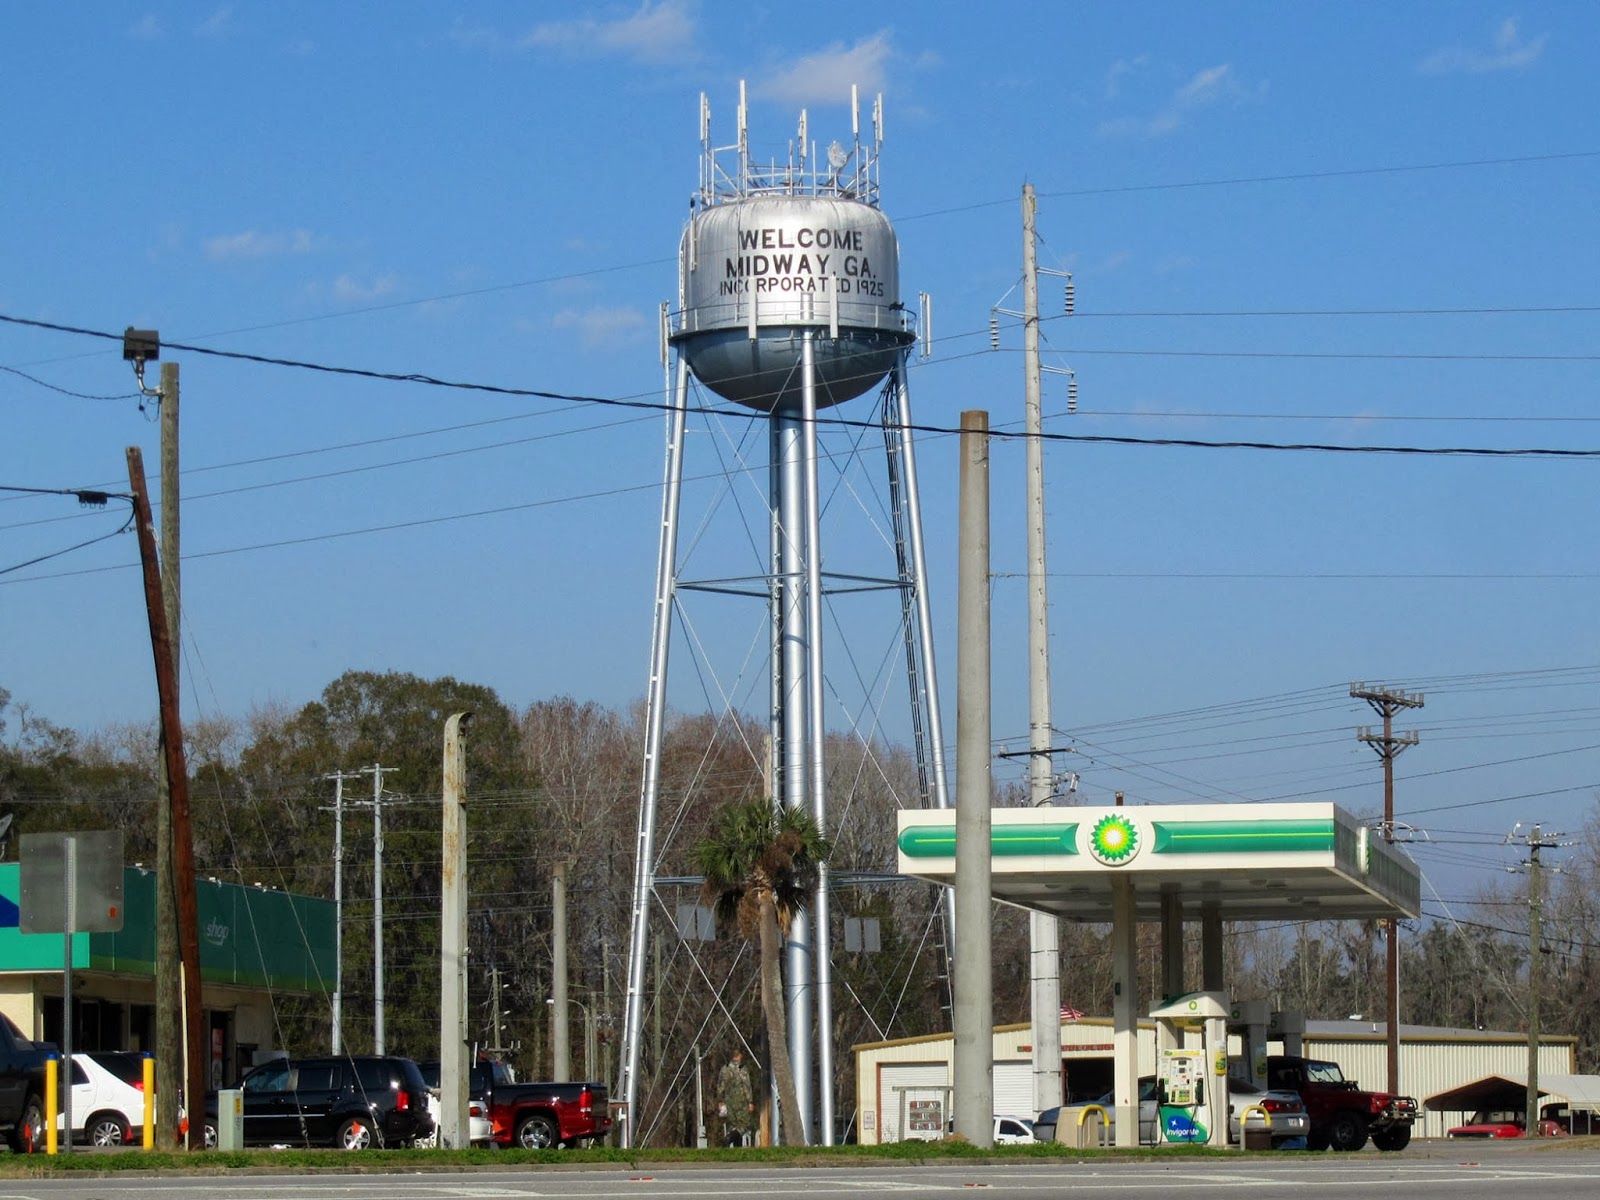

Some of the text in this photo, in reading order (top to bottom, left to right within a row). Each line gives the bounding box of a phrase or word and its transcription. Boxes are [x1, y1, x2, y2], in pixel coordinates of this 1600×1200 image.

[739, 228, 863, 251] WELCOME
[844, 255, 876, 280] GA.
[856, 279, 884, 297] 1925
[207, 915, 230, 946] shop
